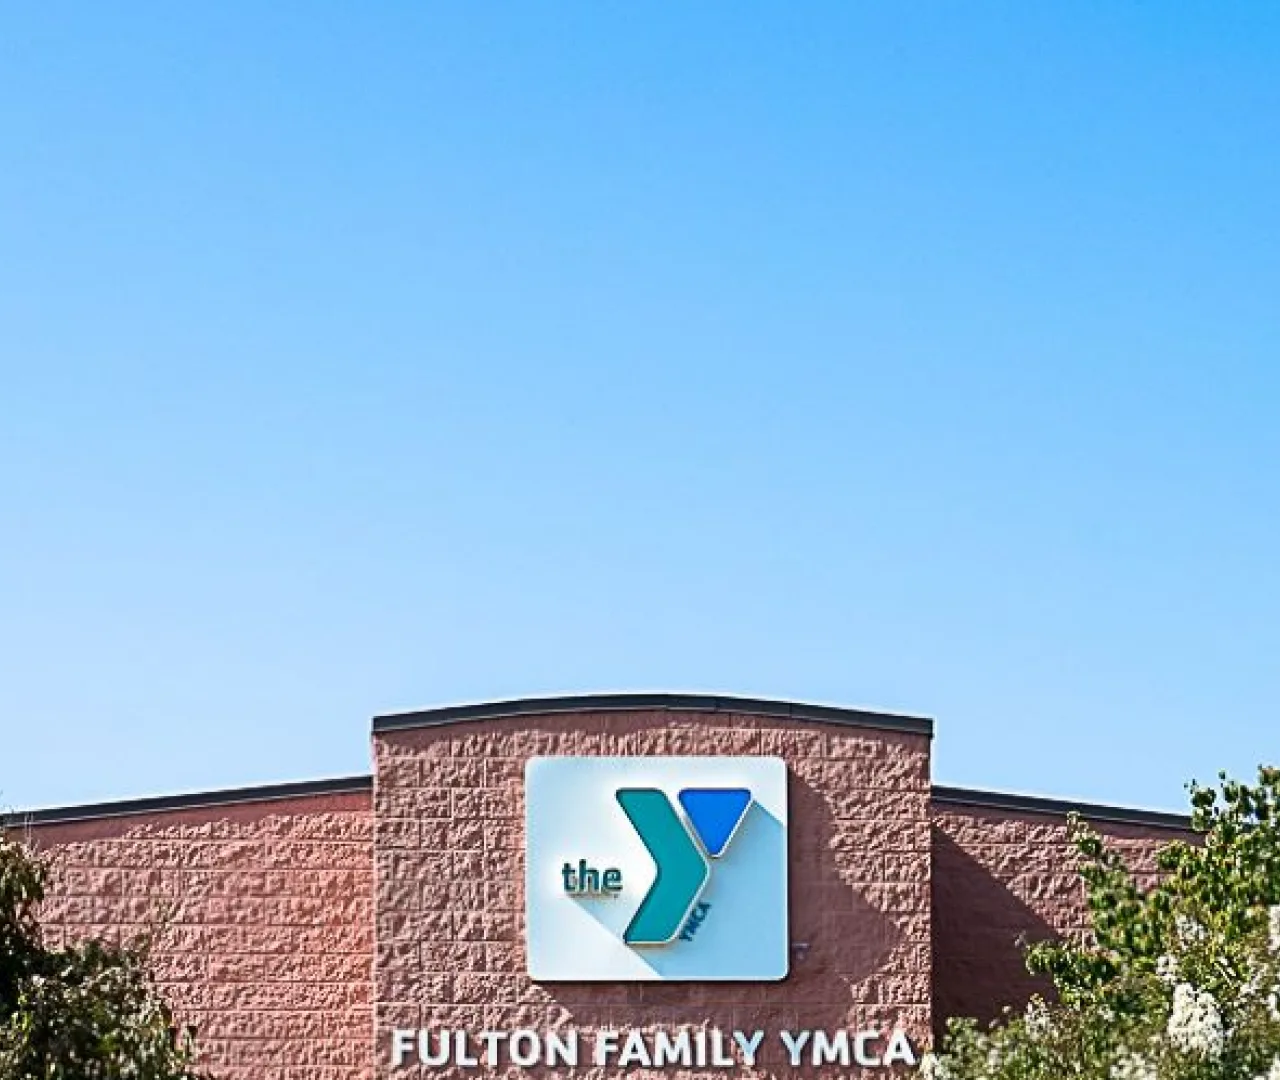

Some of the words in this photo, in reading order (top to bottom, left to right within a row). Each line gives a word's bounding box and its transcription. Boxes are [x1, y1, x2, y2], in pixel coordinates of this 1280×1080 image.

[562, 859, 622, 893] the
[679, 902, 711, 941] YMCA
[391, 1029, 577, 1067] FULTON
[596, 1029, 765, 1067] FAMILY
[779, 1029, 916, 1067] YMCA
